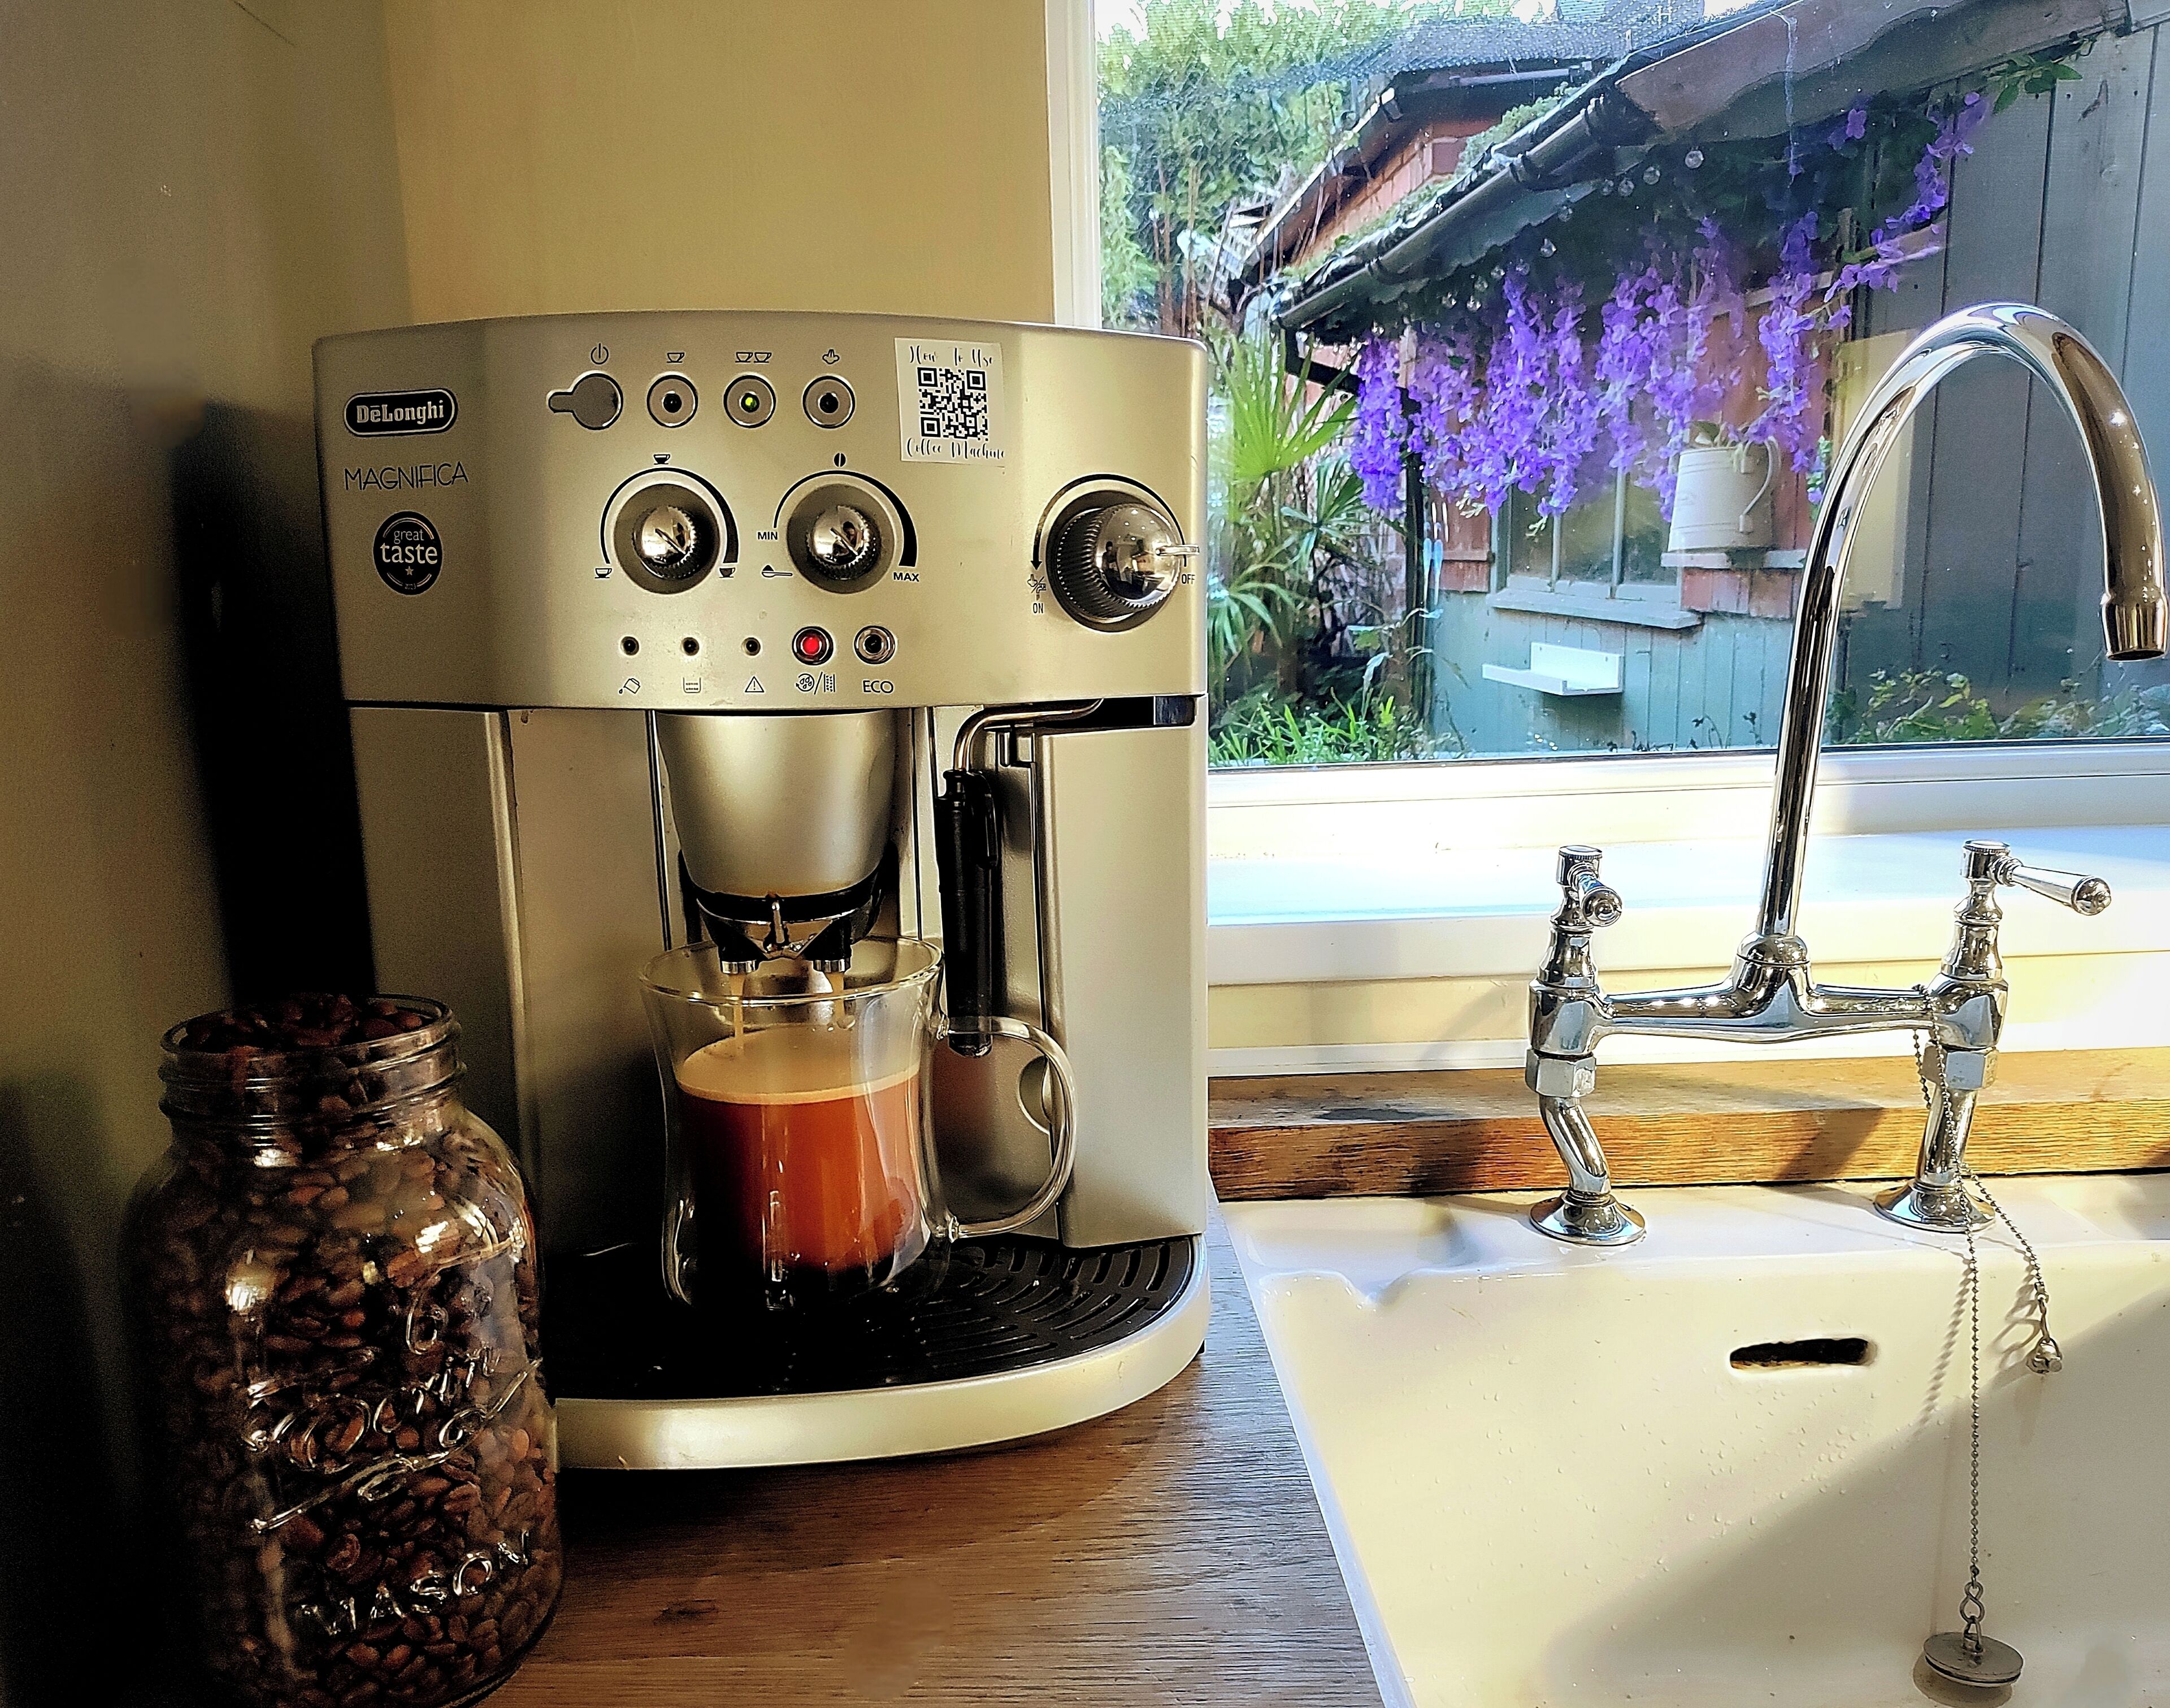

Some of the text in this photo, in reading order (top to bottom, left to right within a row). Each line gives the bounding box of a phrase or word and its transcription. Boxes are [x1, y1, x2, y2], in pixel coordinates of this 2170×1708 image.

[344, 461, 468, 491] MAGNIFICA
[394, 529, 424, 544] great
[757, 530, 778, 540] MIN
[380, 542, 438, 565] taste
[893, 571, 919, 582] MAX
[1181, 574, 1196, 584] OFF
[1032, 602, 1044, 614] ON
[862, 680, 894, 693] ECO
[298, 1529, 530, 1636] MASON
